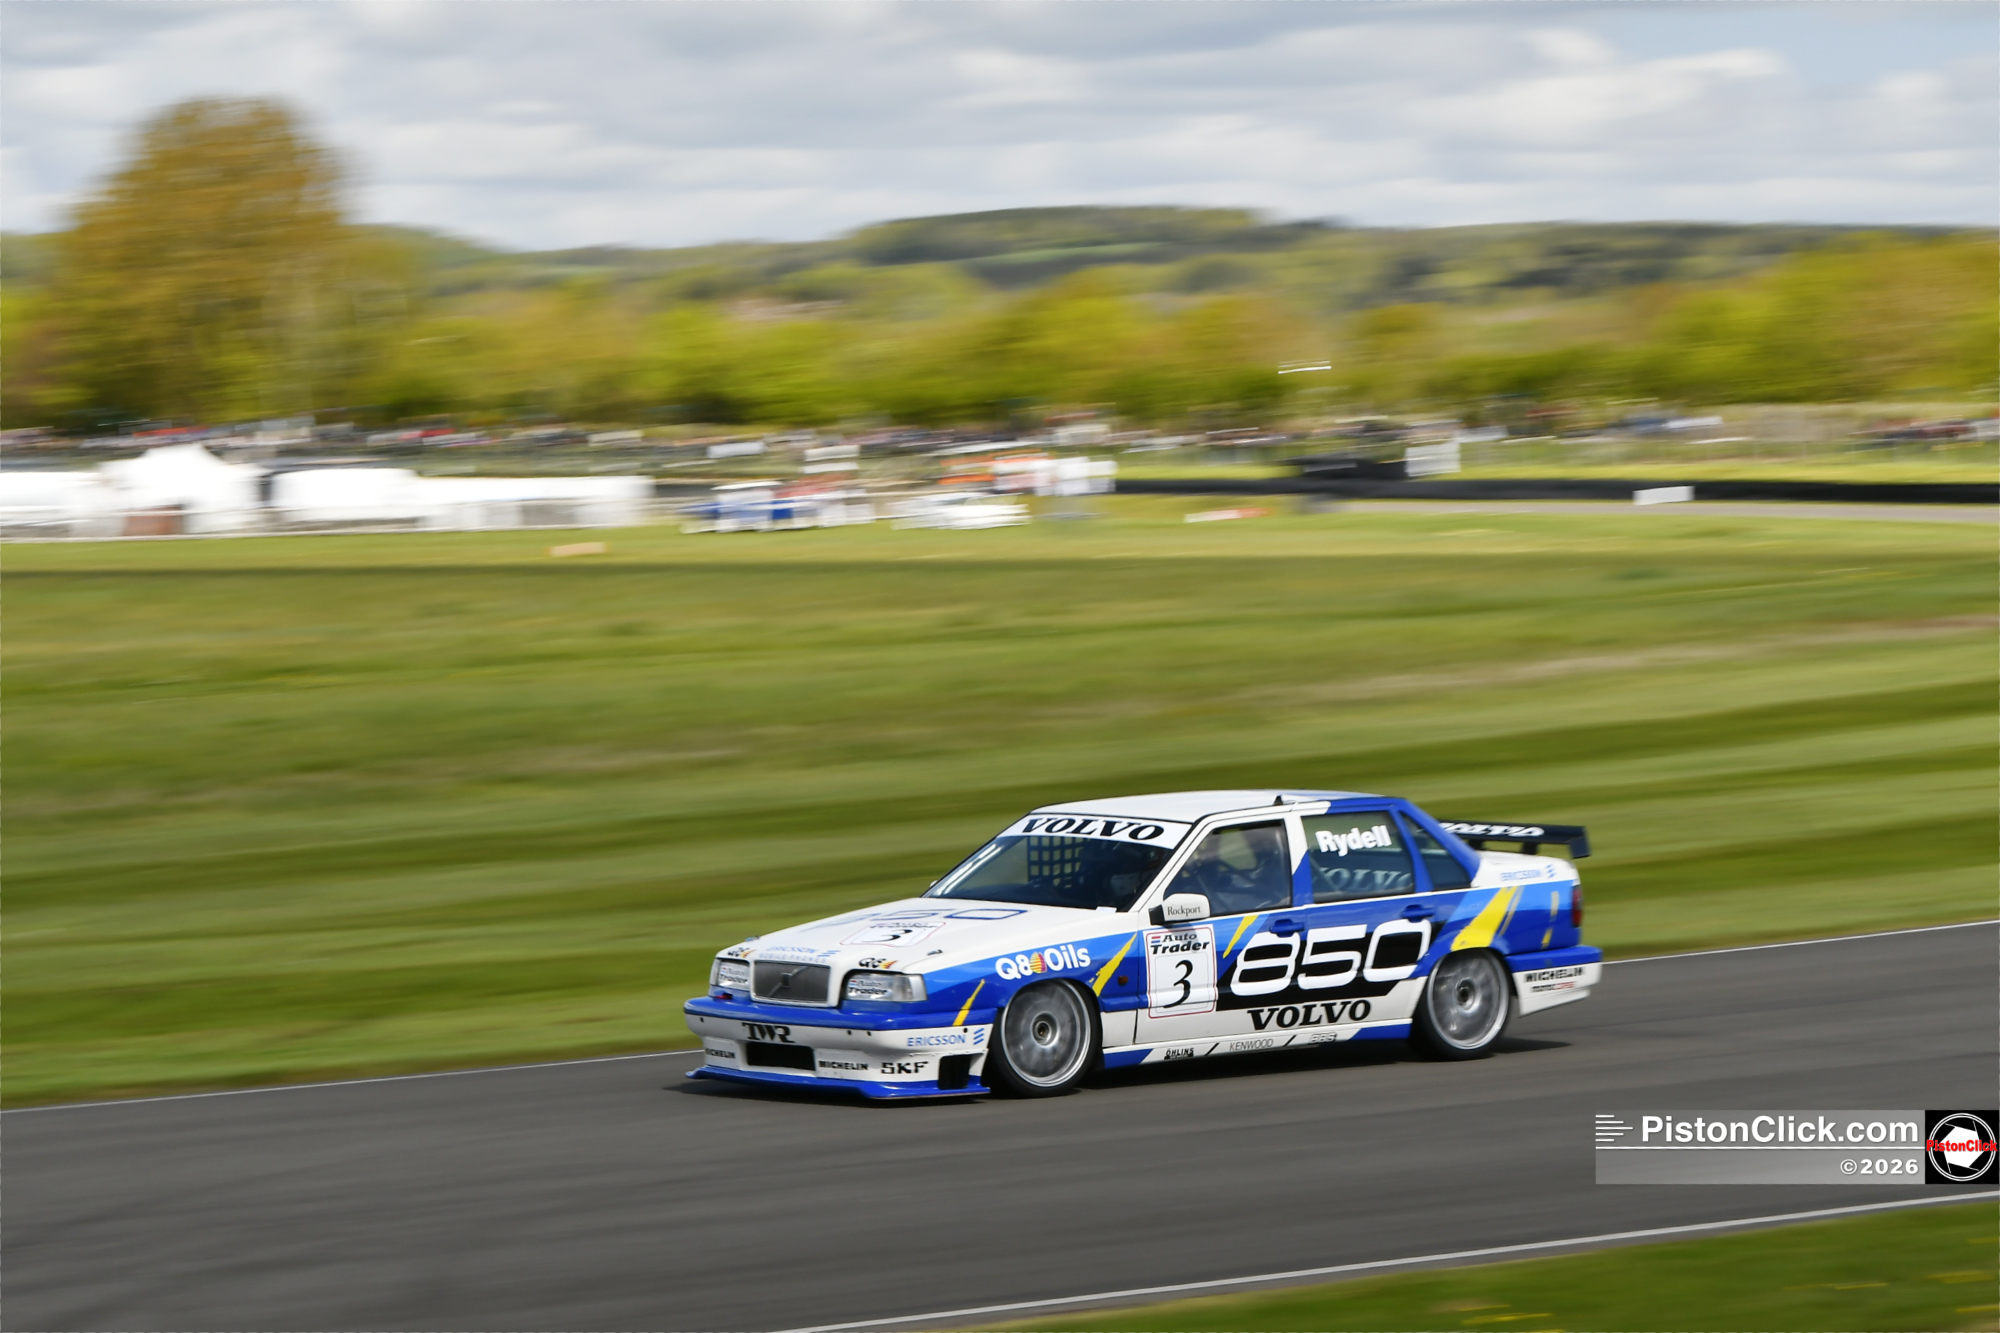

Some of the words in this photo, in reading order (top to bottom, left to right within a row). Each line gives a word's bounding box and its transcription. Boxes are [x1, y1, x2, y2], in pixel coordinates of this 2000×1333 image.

[1022, 817, 1165, 841] VOLVO
[1315, 825, 1392, 857] Rydell
[1167, 905, 1201, 917] Rockport
[1162, 932, 1198, 942] Auto
[1150, 941, 1211, 955] Trader
[995, 957, 1032, 981] Q8
[1045, 944, 1091, 972] Oils
[1230, 918, 1432, 996] 850
[1162, 959, 1194, 1009] 3
[1247, 999, 1372, 1030] VOLVO
[741, 1022, 795, 1043] TWR
[907, 1034, 967, 1047] ERICSSON
[1229, 1038, 1274, 1051] KENWOOD
[818, 1060, 869, 1070] MICHELIN
[881, 1061, 929, 1074] SKF
